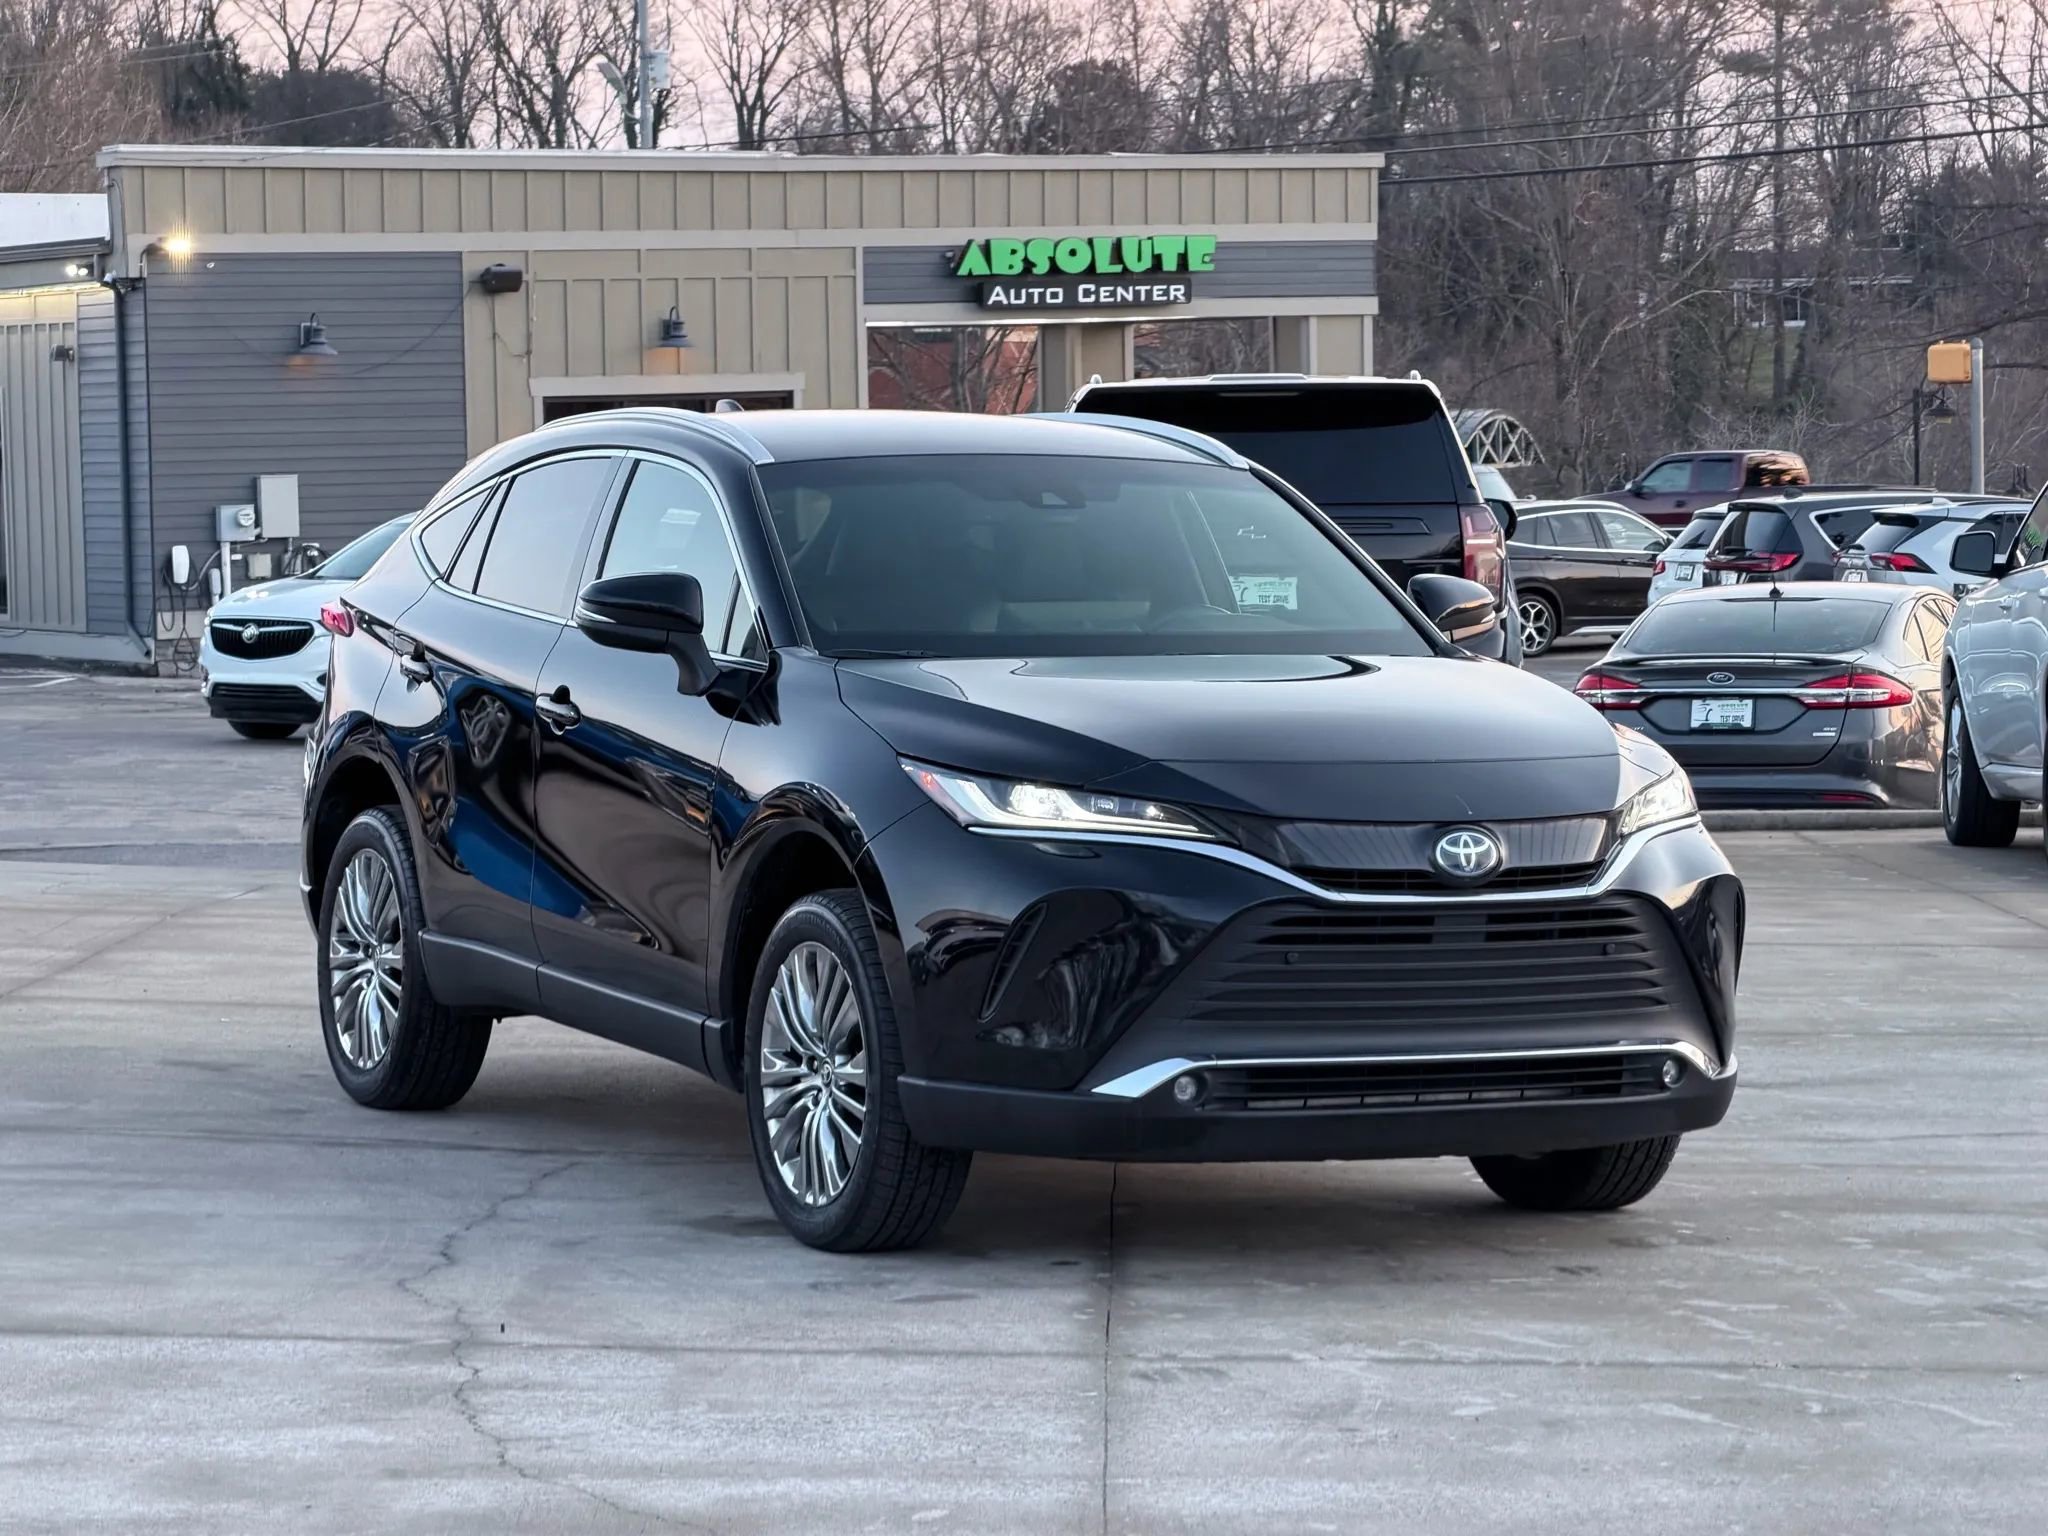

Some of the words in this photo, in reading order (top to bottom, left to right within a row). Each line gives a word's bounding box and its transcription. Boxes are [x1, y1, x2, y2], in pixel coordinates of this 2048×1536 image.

[956, 235, 1216, 276] ABSOLUTE
[987, 285, 1064, 305] AUTO
[1077, 283, 1187, 303] CENTER
